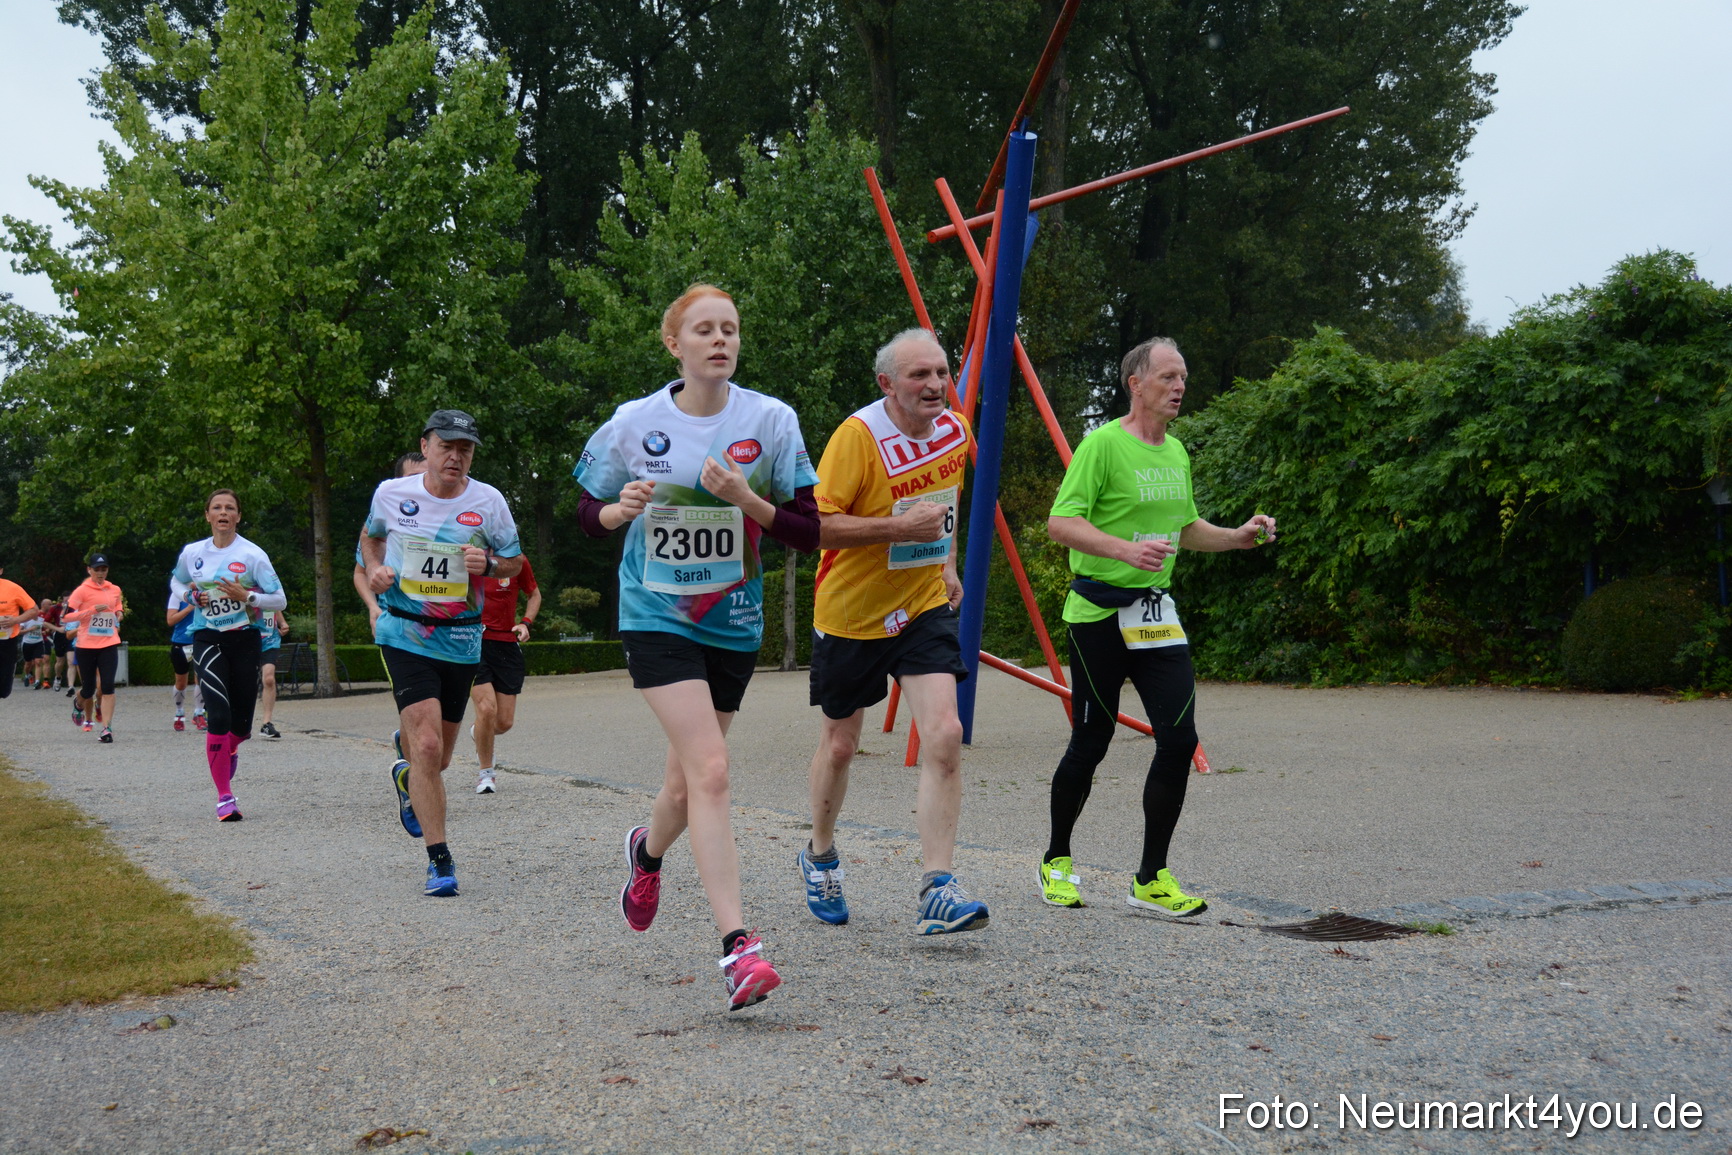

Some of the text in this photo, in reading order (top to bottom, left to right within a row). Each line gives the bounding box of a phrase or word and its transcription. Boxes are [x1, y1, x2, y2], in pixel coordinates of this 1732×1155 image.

[645, 460, 672, 469] PARTL
[890, 471, 936, 500] MAX
[685, 510, 734, 521] BOCK
[653, 527, 734, 560] 2300
[911, 545, 945, 559] Johann
[421, 556, 450, 580] 44
[674, 567, 712, 583] Sarah
[419, 584, 448, 595] Lothar
[730, 591, 750, 606] 17.
[1141, 599, 1163, 623] 20
[92, 617, 113, 628] 2319
[213, 616, 234, 627] Conny
[1139, 629, 1171, 640] Thomas
